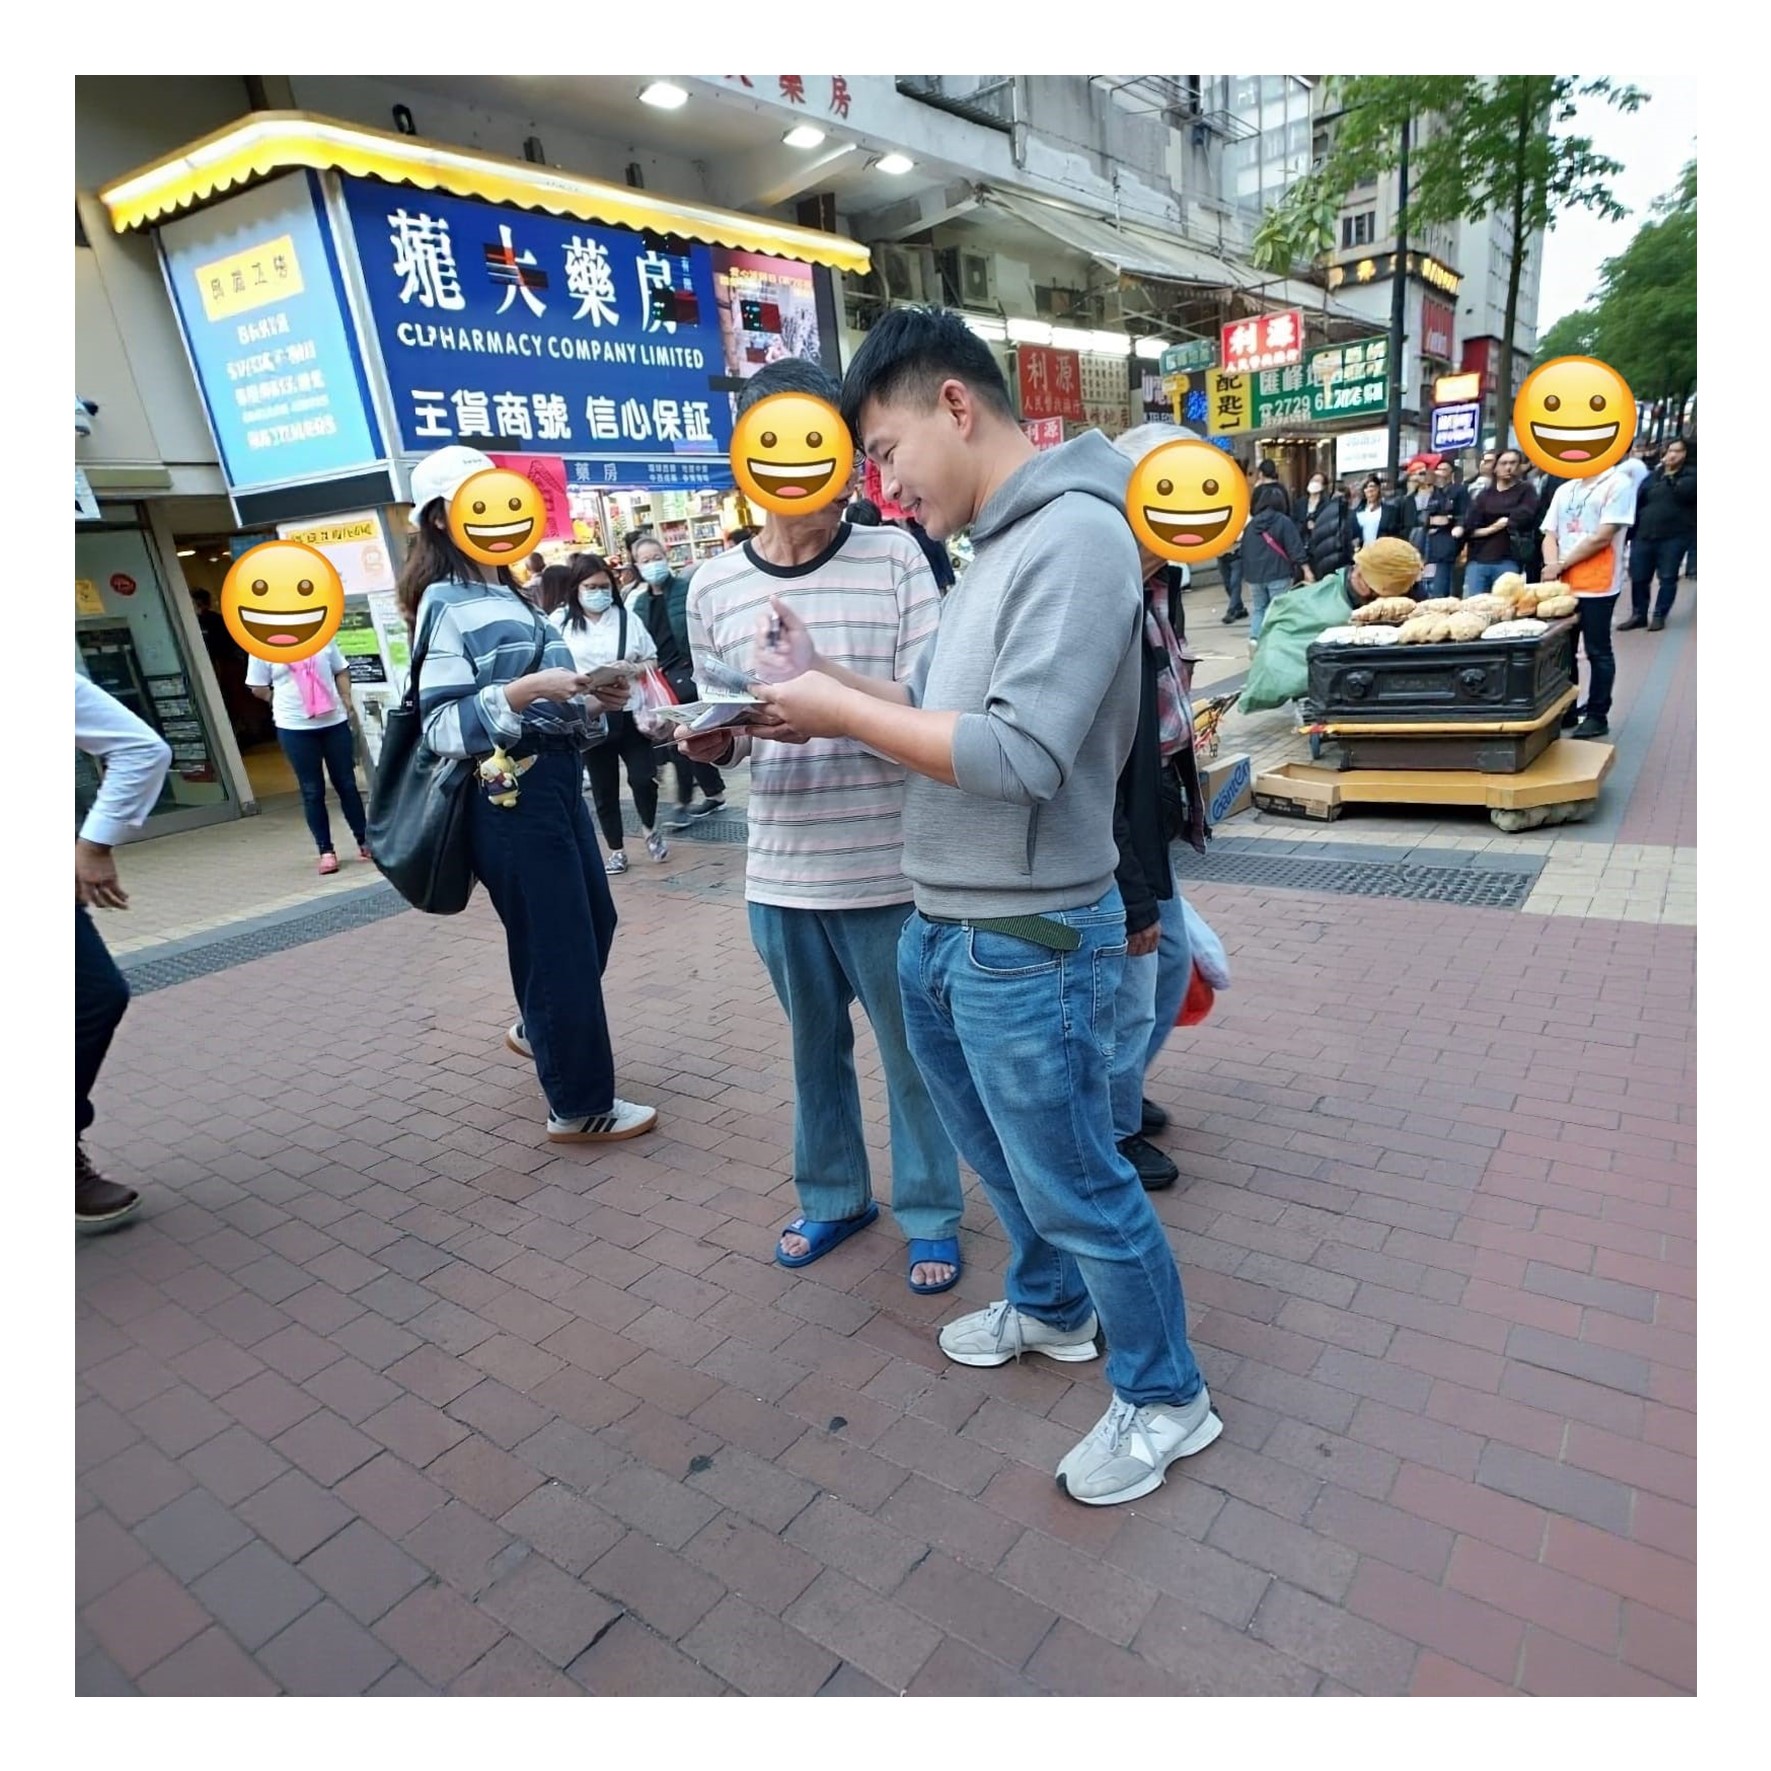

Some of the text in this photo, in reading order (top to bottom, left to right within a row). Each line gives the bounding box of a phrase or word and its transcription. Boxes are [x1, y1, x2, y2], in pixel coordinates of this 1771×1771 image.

[547, 335, 638, 364] COMPANY
[641, 344, 704, 369] LIMITED
[1027, 352, 1075, 394] 利源
